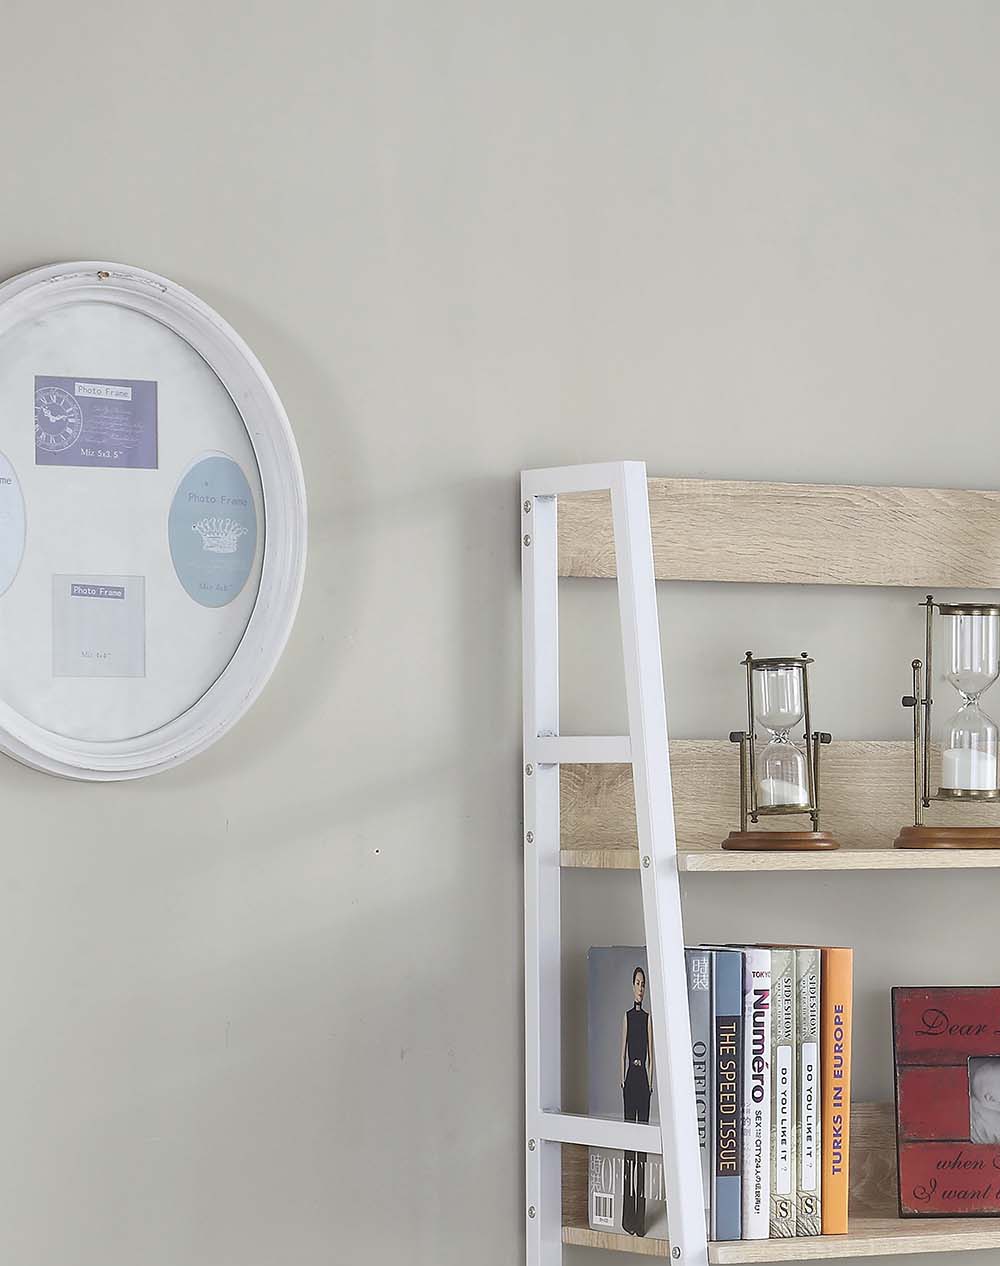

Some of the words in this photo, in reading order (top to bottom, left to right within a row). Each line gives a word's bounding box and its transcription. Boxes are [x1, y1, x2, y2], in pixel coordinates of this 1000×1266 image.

[78, 385, 102, 395] Photo
[188, 492, 217, 504] Photo
[73, 585, 96, 595] Photo
[784, 977, 792, 1040] SIDESHOW
[808, 974, 816, 1037] SIDESHOW
[915, 1008, 988, 1037] Dear
[719, 1022, 736, 1056] THE
[751, 988, 770, 1104] Numéro
[833, 1004, 844, 1080] EUROPE
[781, 1067, 788, 1085] DO
[806, 1063, 813, 1082] DO
[719, 1060, 736, 1114] SPEED
[832, 1087, 844, 1108] IN
[719, 1118, 736, 1172] ISSUE
[781, 1148, 788, 1162] IT
[806, 1144, 813, 1159] IT
[832, 1115, 843, 1175] TURKS
[936, 1152, 986, 1170] when
[912, 1178, 937, 1204] I
[941, 1184, 992, 1200] want
